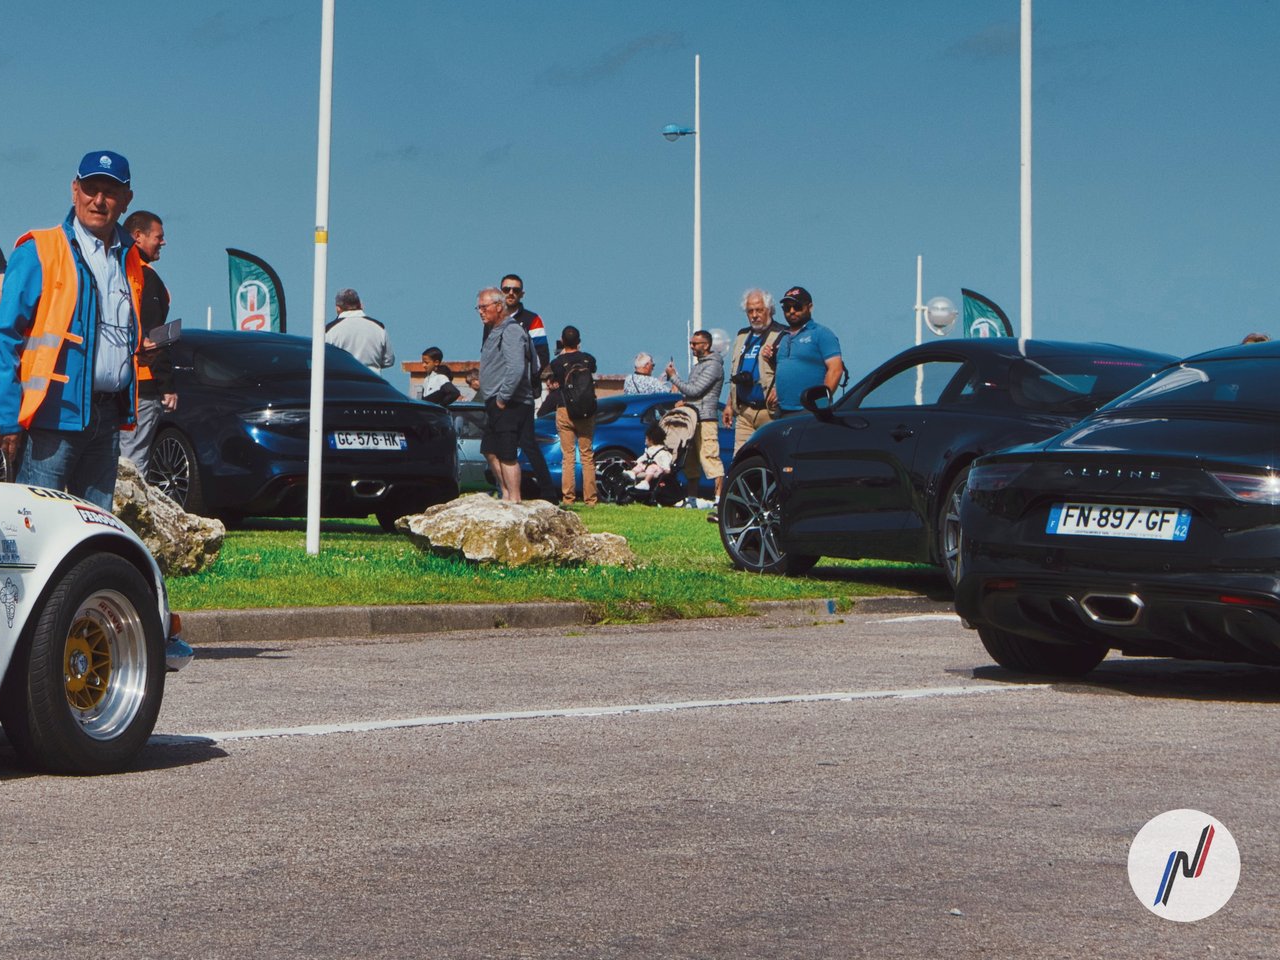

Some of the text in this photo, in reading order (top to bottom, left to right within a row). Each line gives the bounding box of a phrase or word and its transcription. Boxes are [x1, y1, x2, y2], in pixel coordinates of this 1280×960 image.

[1064, 468, 1161, 480] ALPINE
[1062, 505, 1176, 532] FN-897-GF
[1175, 525, 1187, 537] 42
